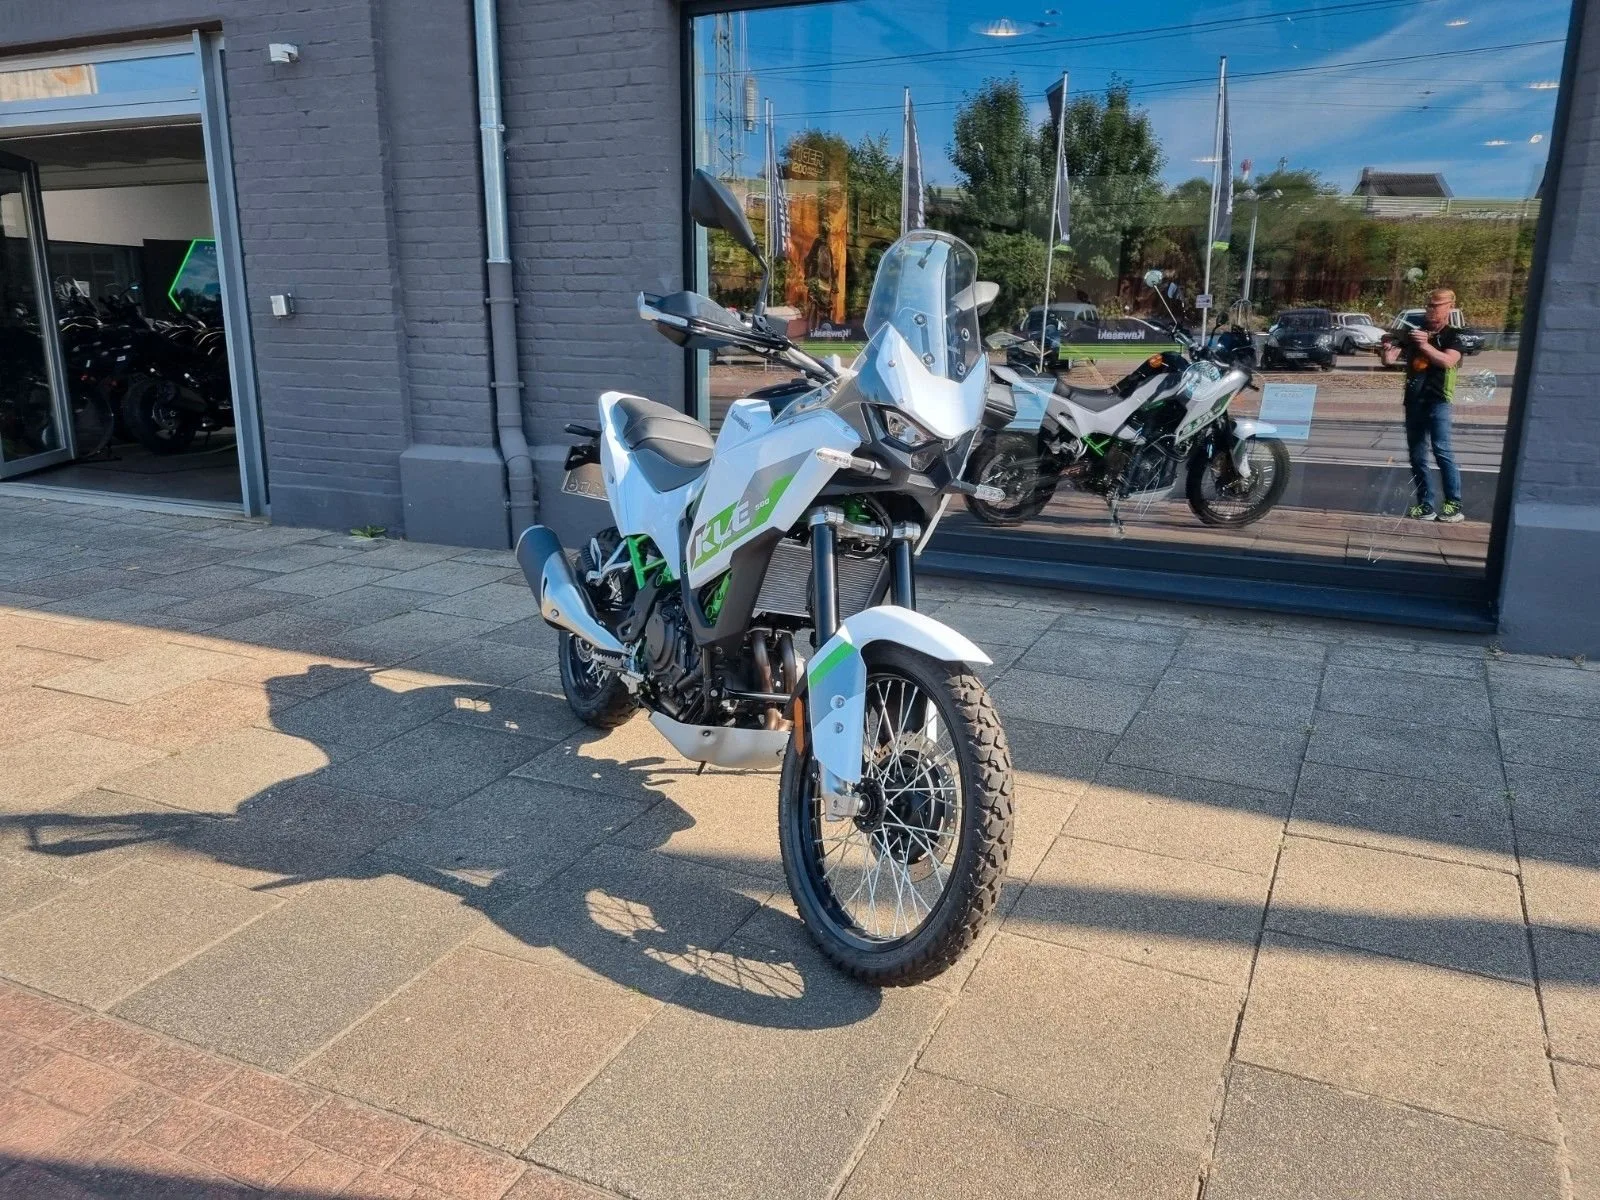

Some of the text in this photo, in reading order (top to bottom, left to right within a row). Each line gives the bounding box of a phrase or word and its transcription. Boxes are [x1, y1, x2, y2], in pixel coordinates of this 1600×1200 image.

[791, 143, 824, 168] TIGER
[791, 162, 808, 175] 1200
[731, 408, 752, 432] Kawasaki
[695, 498, 769, 558] KLE 500
